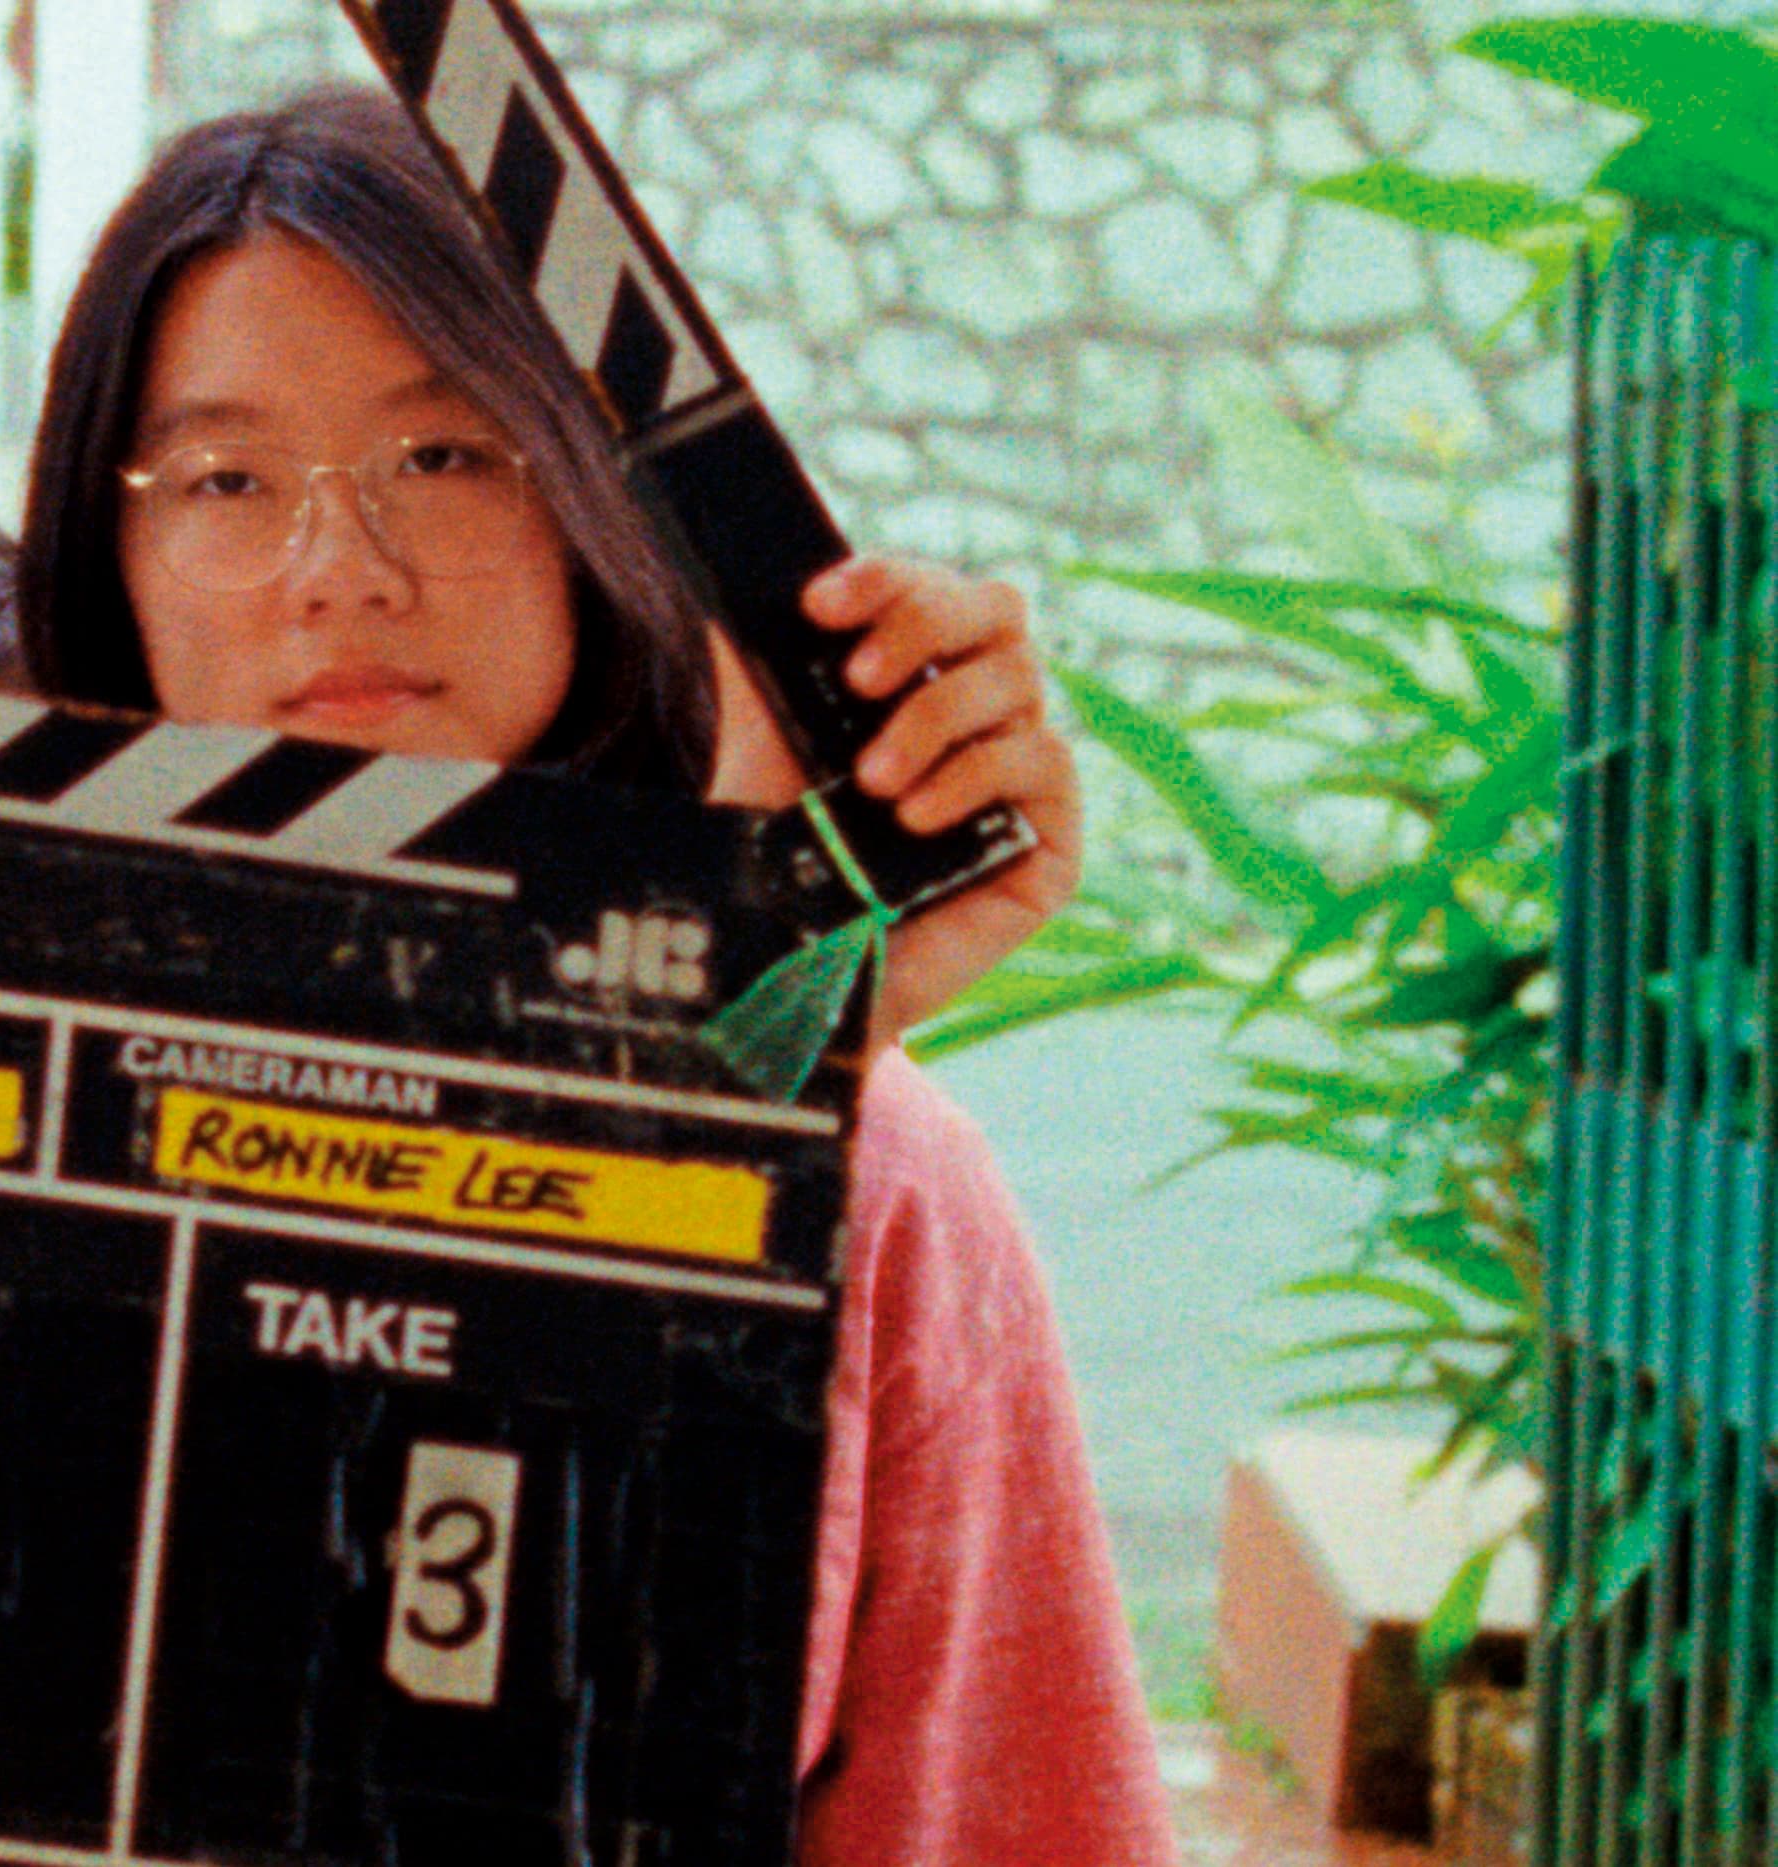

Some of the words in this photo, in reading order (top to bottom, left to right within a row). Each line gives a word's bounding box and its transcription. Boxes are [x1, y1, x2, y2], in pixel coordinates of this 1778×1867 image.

[122, 1038, 439, 1116] CAMERAMAN
[180, 1108, 442, 1192] RONNIE
[453, 1149, 593, 1222] LEE
[245, 1283, 458, 1378] TAKE
[405, 1500, 496, 1650] 3
